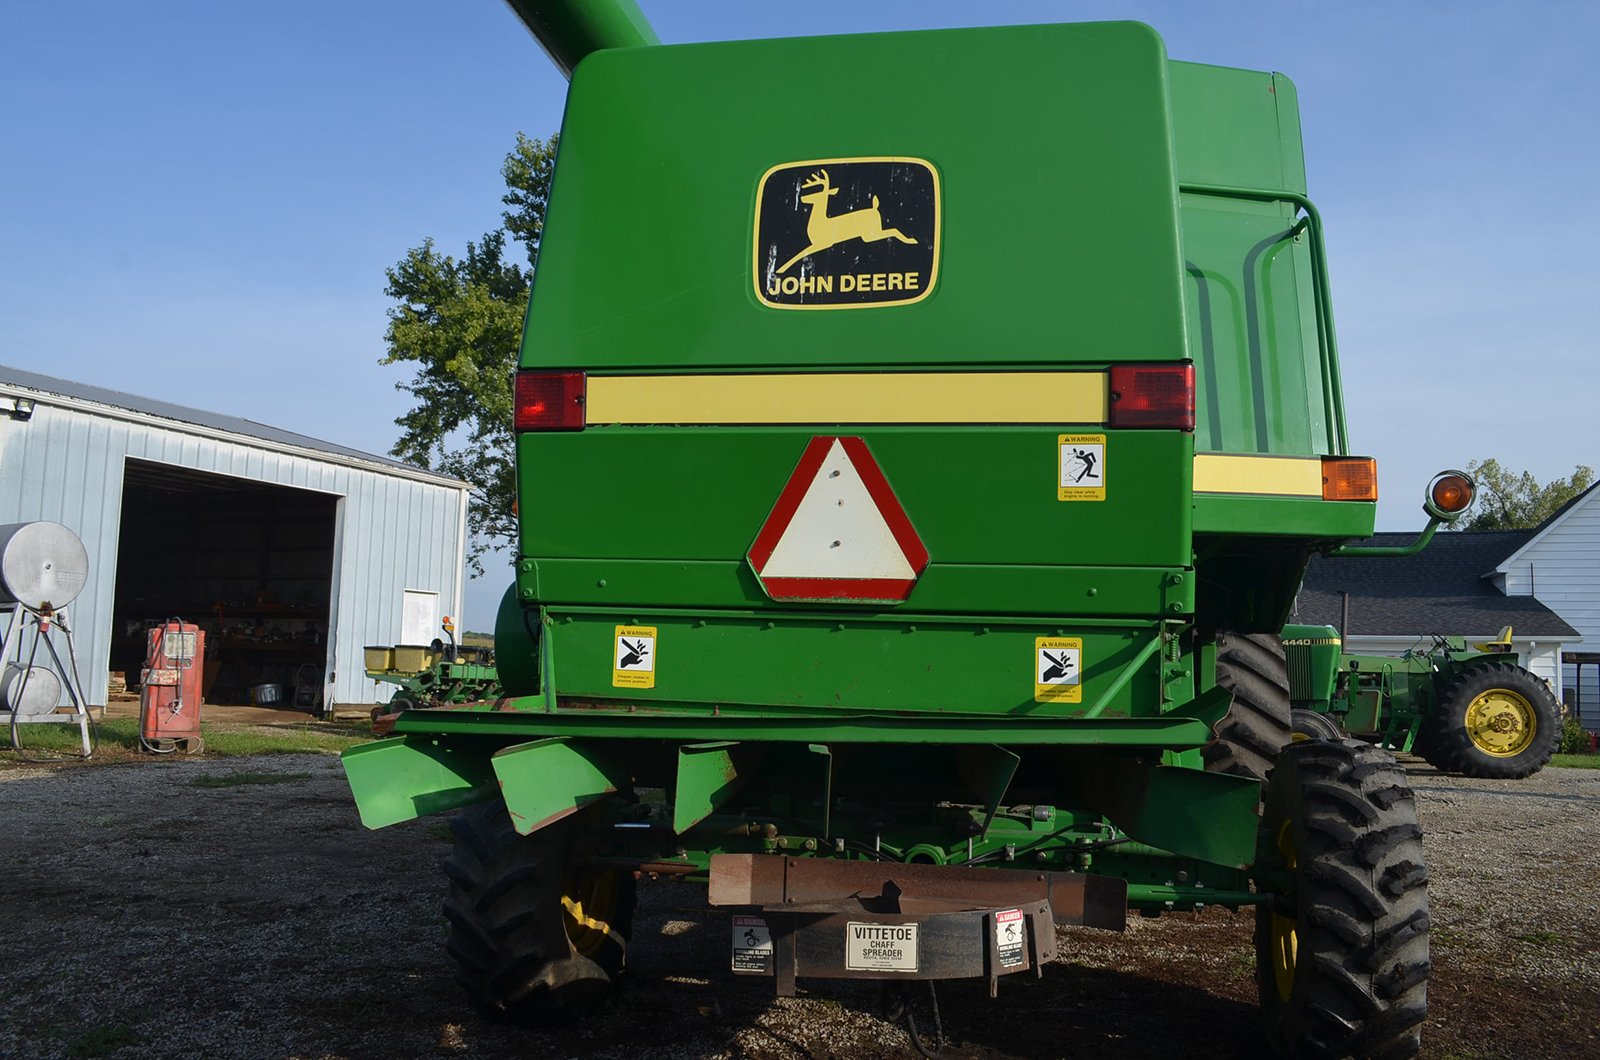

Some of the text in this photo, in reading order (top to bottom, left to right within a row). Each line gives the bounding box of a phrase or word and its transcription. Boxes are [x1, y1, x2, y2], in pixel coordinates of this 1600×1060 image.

[768, 272, 919, 296] JOHN DEERE
[854, 927, 912, 941] VITTETOE
[870, 940, 895, 949] CHAFF
[862, 948, 903, 957] SPREADER
